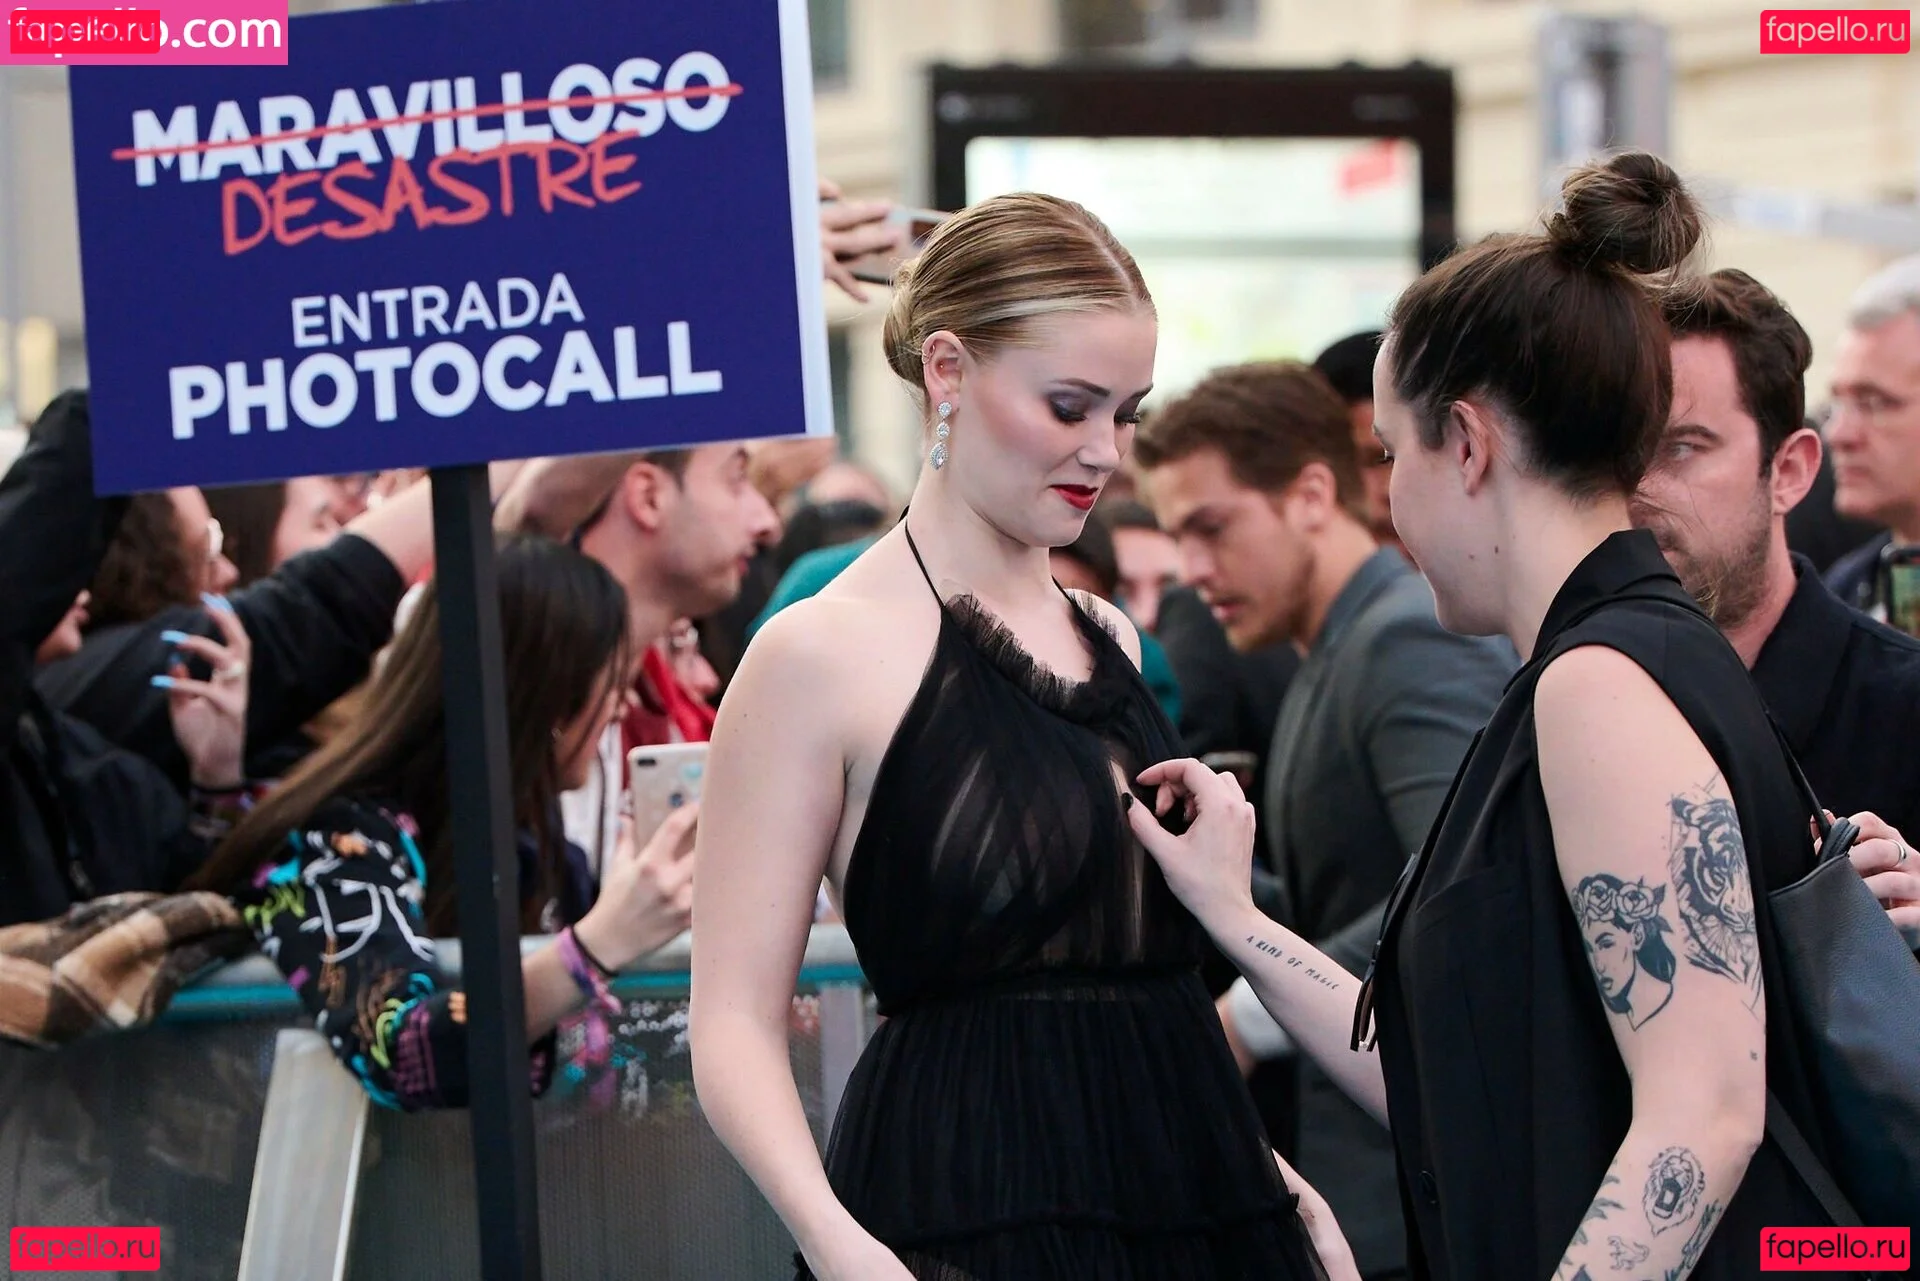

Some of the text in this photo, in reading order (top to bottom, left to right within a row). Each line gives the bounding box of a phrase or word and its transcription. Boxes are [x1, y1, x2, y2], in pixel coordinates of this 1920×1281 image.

[131, 51, 732, 187] MARAVILLOSO
[222, 130, 642, 256] DESASTRE
[291, 273, 585, 349] ENTRADA
[168, 320, 723, 440] PHOTOCALL
[1246, 935, 1255, 943] A
[1287, 957, 1303, 967] OF
[1305, 968, 1340, 990] MAGIC
